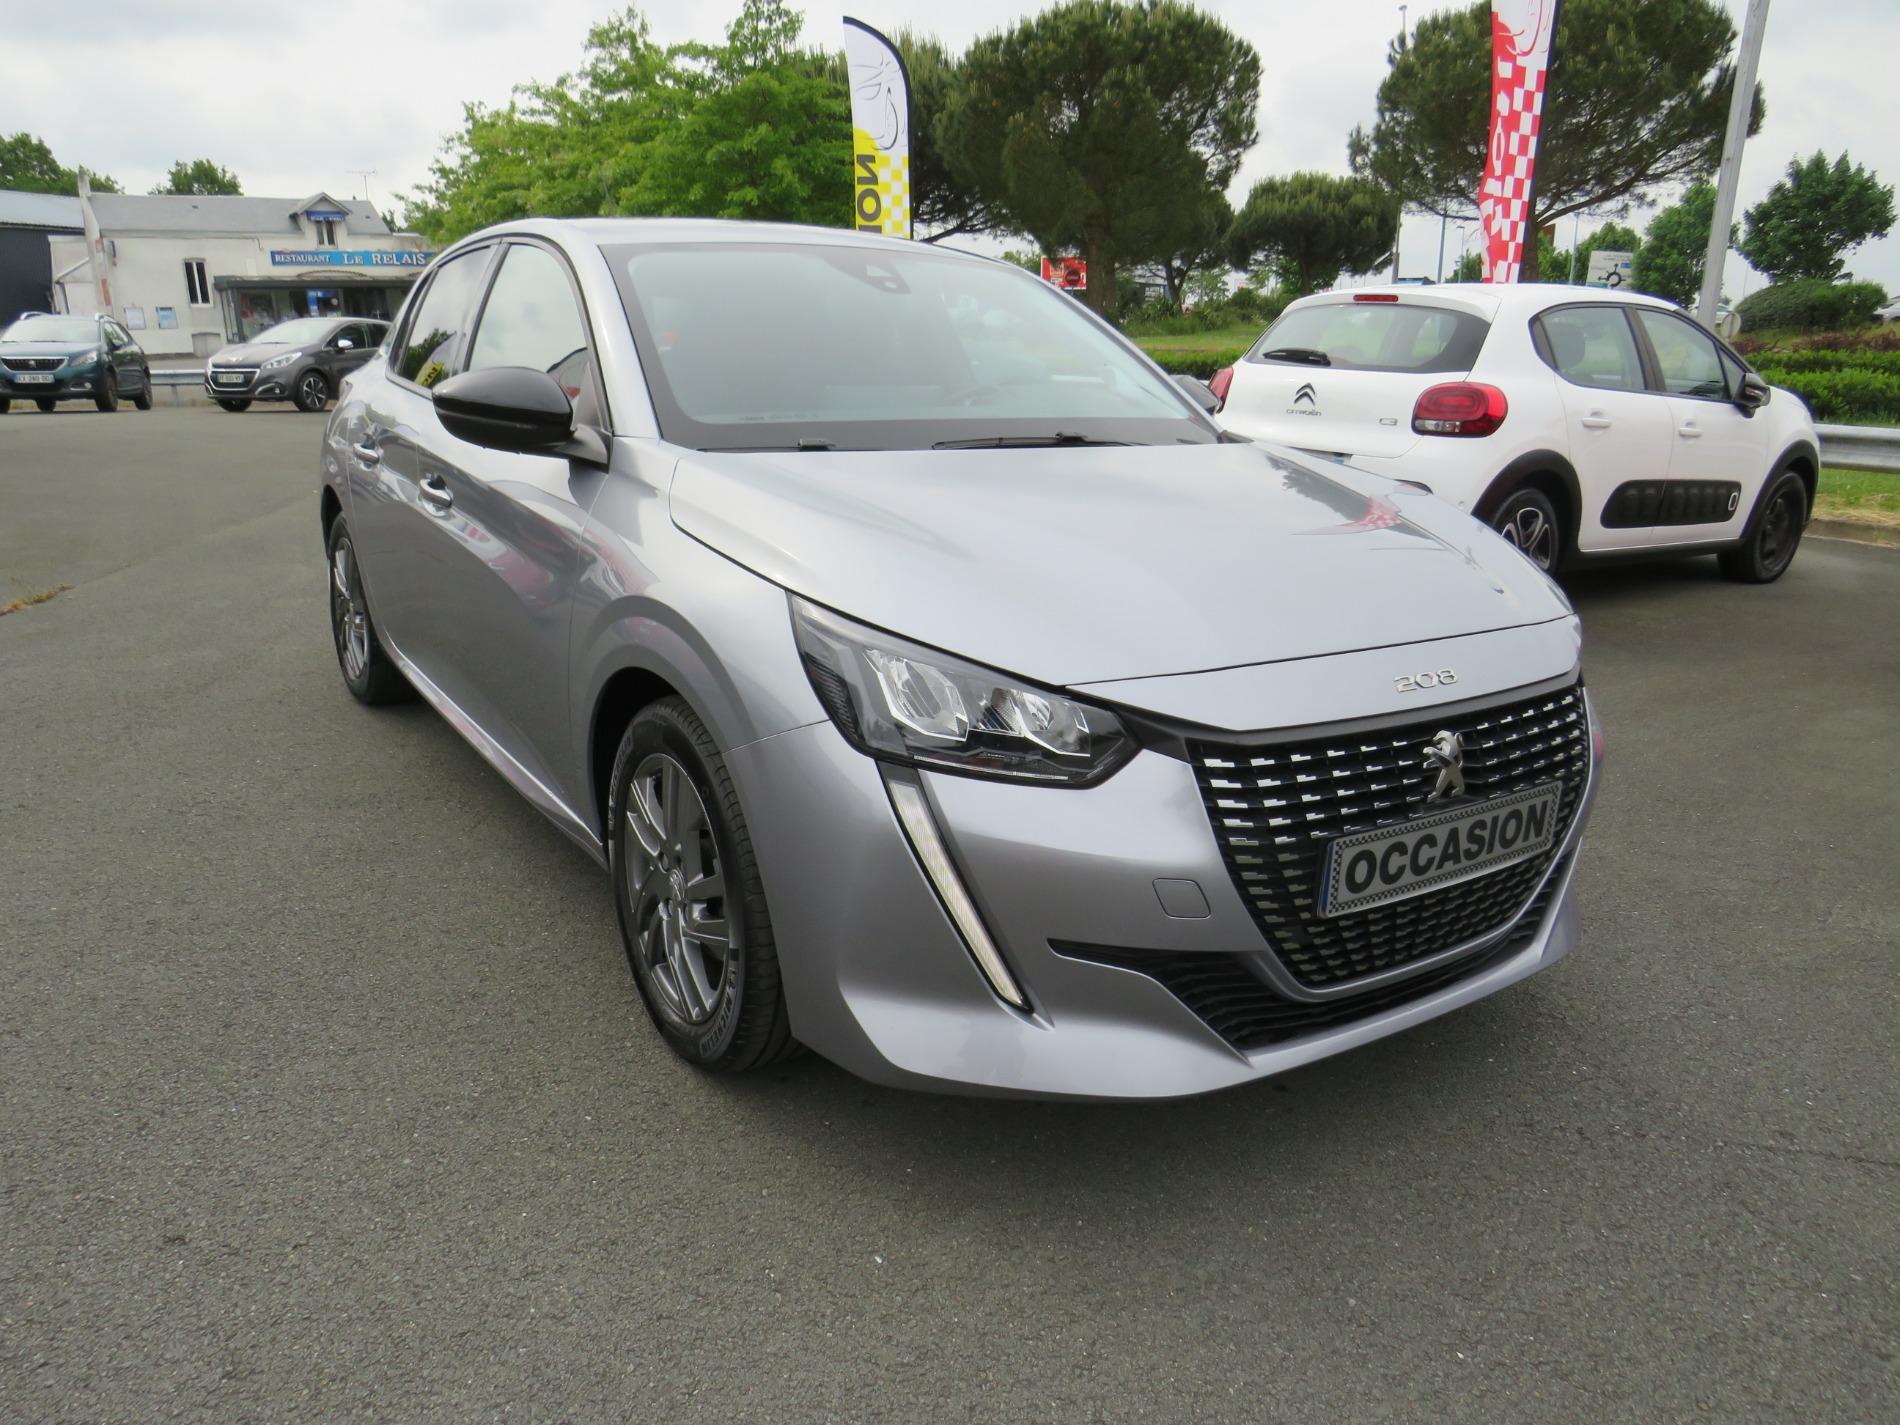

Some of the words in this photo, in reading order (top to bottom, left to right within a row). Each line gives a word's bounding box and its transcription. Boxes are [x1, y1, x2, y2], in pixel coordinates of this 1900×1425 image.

[274, 254, 331, 263] RESTAURANT
[372, 252, 426, 265] RELAIS
[1394, 668, 1458, 693] 208
[1345, 800, 1549, 894] OCCASION
